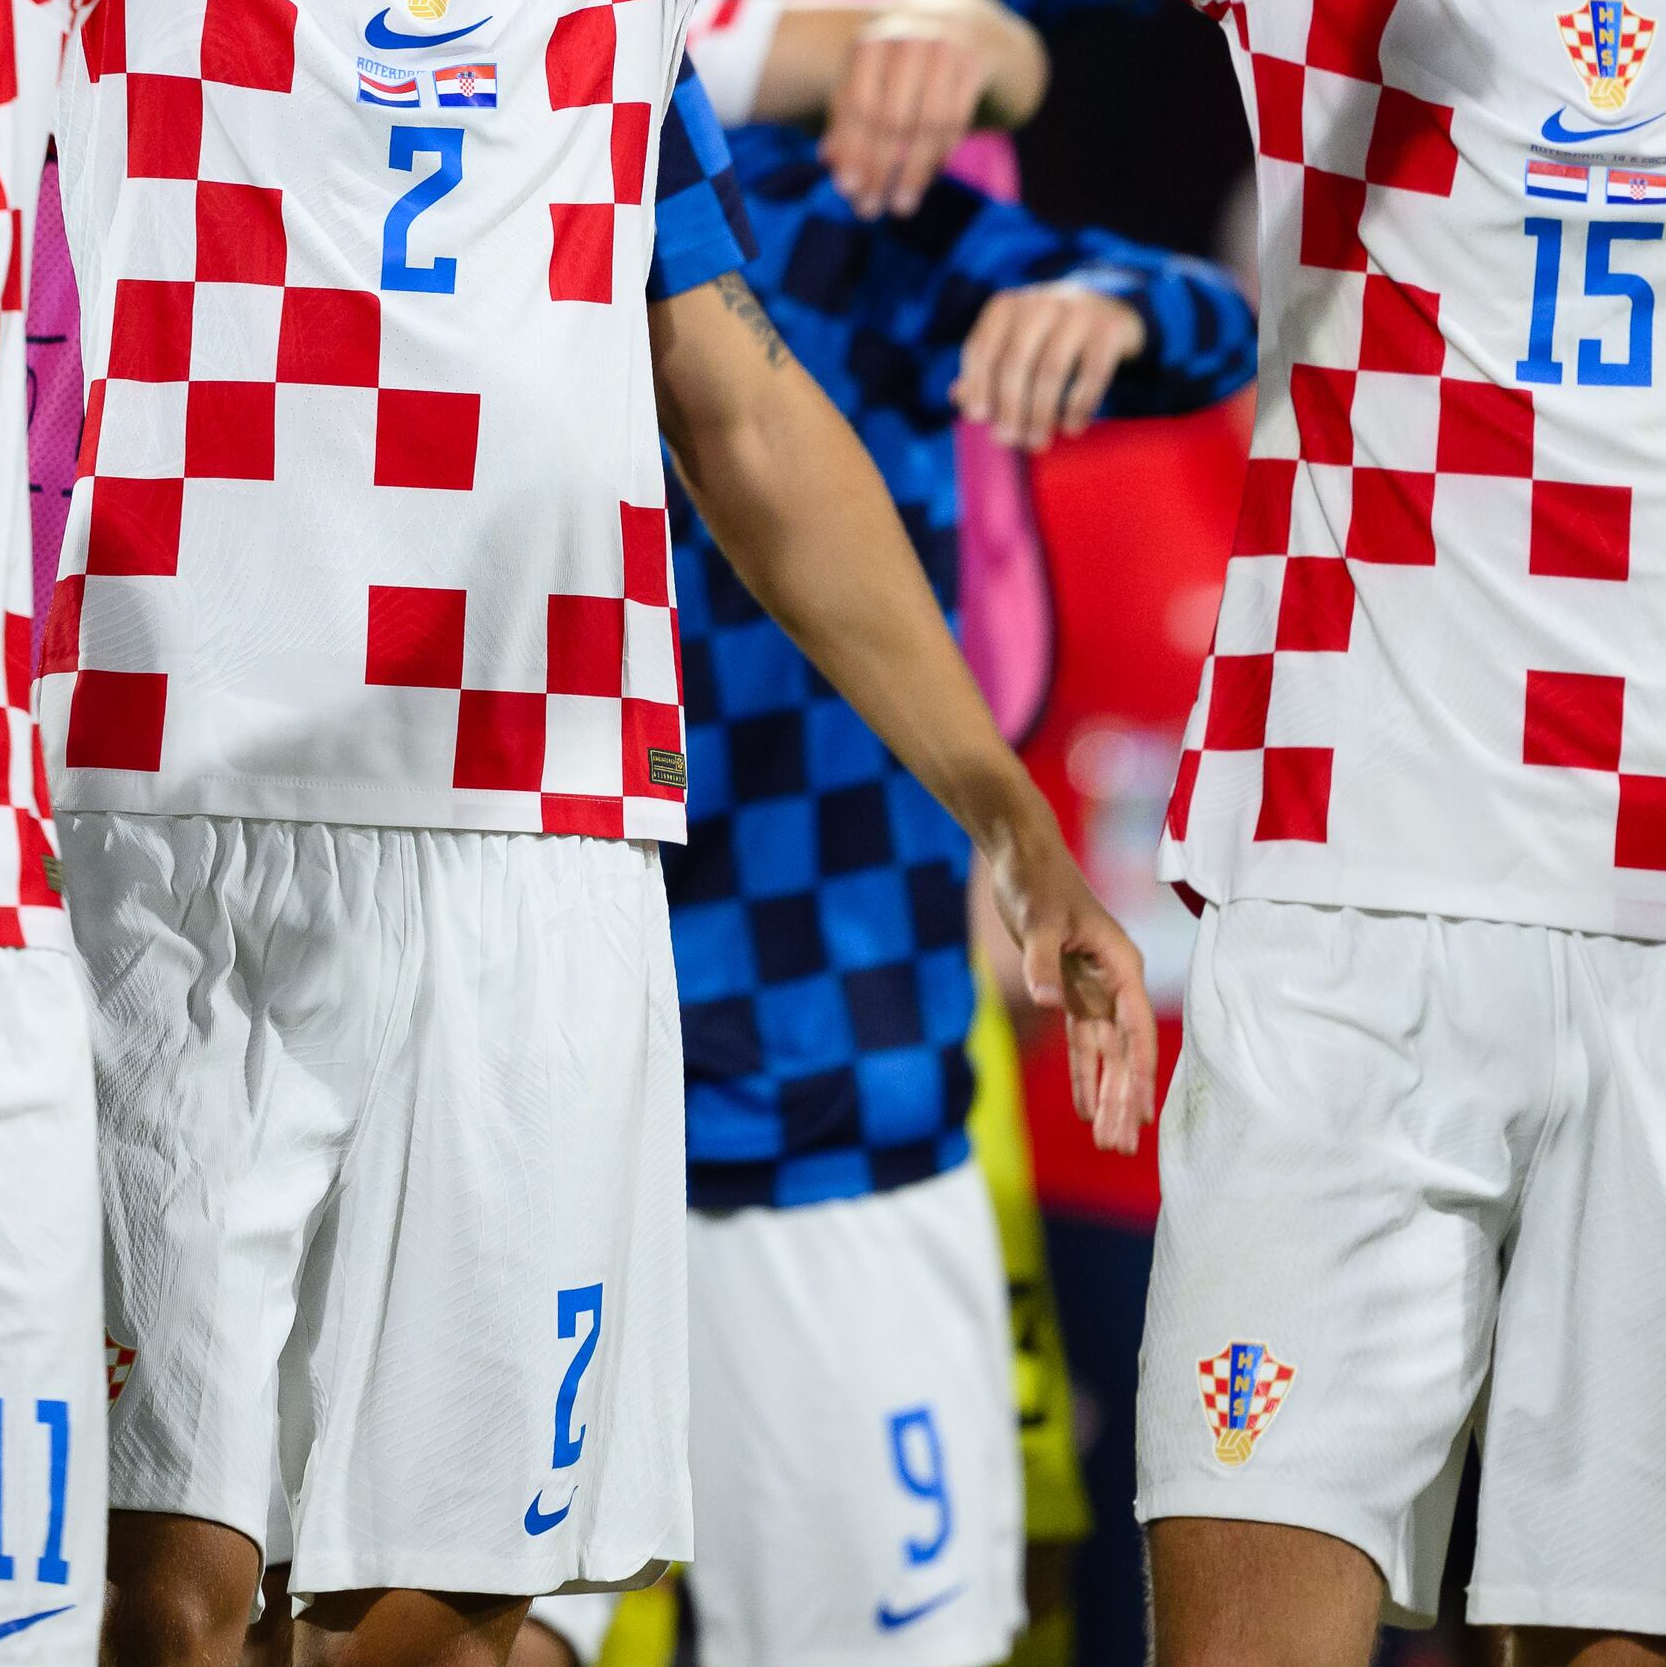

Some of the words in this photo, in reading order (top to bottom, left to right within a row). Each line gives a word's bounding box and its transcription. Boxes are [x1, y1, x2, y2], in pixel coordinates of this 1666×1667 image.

[357, 56, 428, 80] ROTERDA
[1598, 6, 1615, 67] HNS
[381, 126, 464, 294] 2
[1516, 218, 1662, 387] 15
[553, 1283, 603, 1469] 2
[1233, 1352, 1253, 1417] HNS
[887, 1406, 952, 1567] 9
